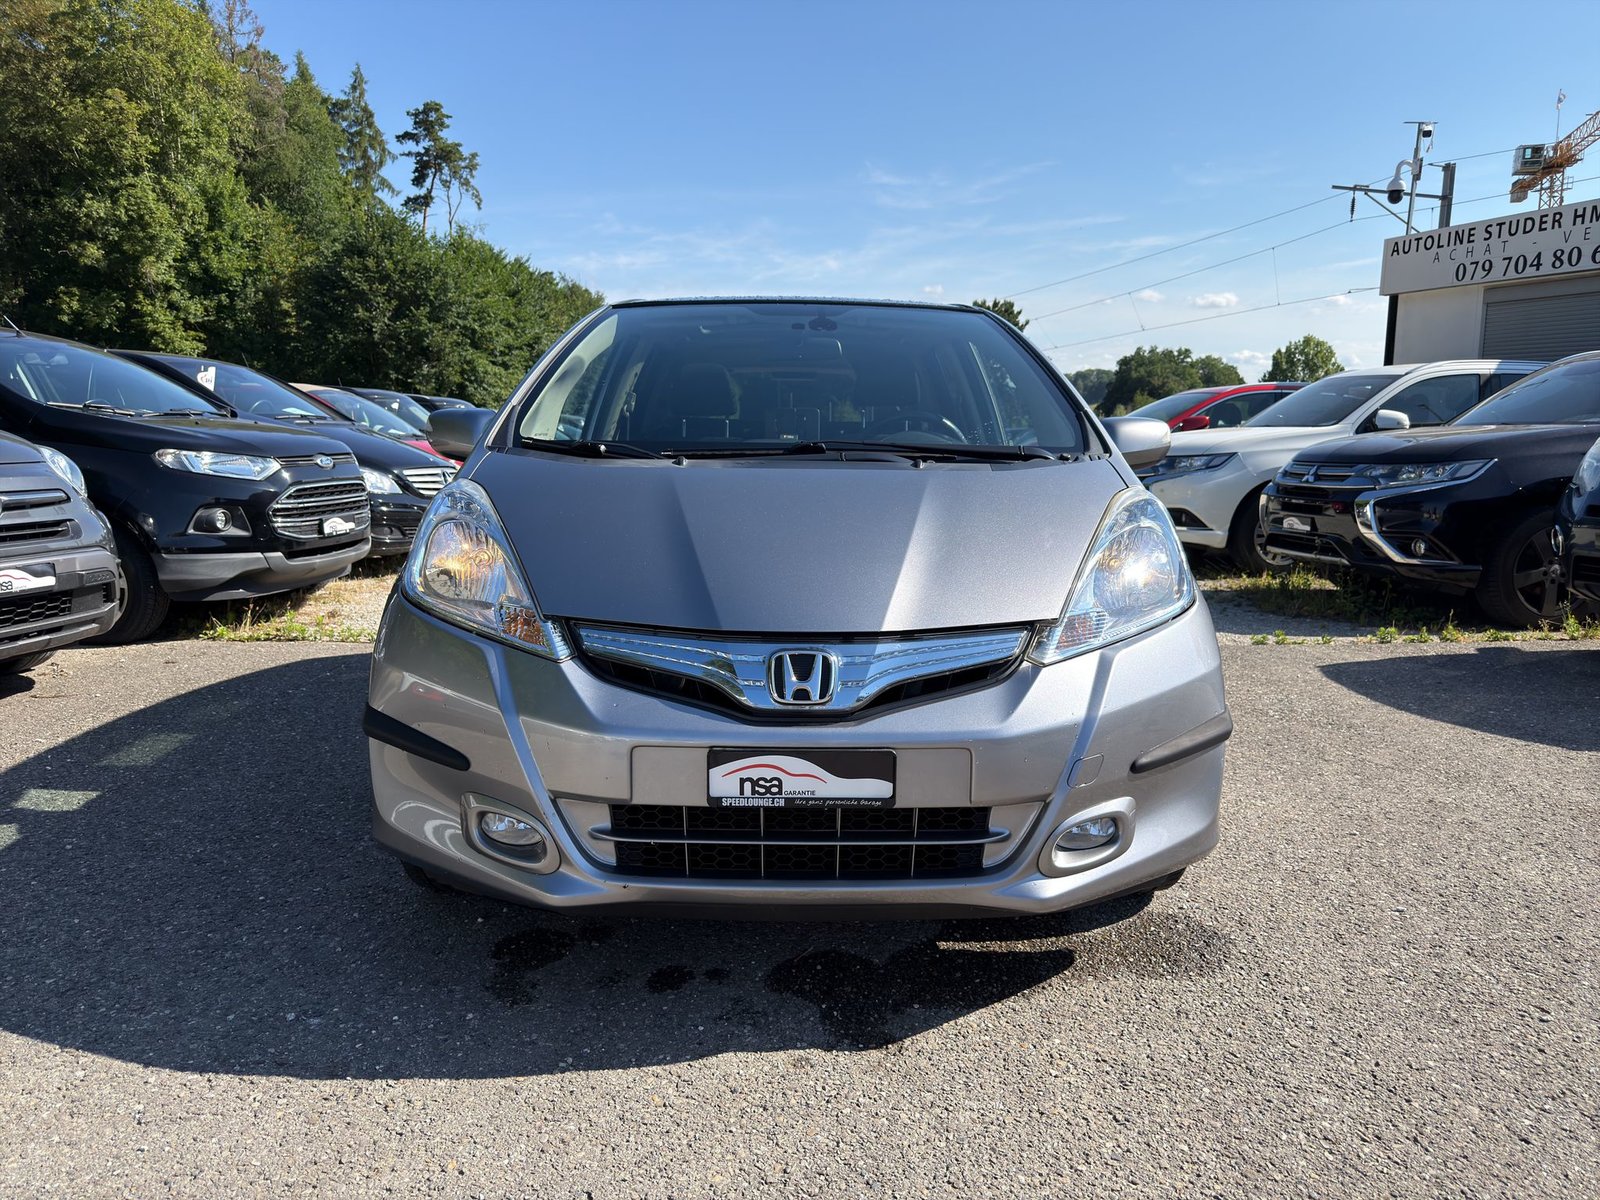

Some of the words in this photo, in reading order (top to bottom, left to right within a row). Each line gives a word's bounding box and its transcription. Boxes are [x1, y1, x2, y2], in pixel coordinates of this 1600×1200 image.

[1391, 227, 1476, 256] AUTOLINE
[1483, 211, 1563, 241] STUDER
[1433, 240, 1508, 263] ACHAT
[1455, 259, 1493, 282] 079
[1502, 252, 1543, 276] 704
[1551, 246, 1582, 269] 80
[739, 777, 782, 796] nsa
[722, 798, 785, 807] SPEEDLOUNGE.CH
